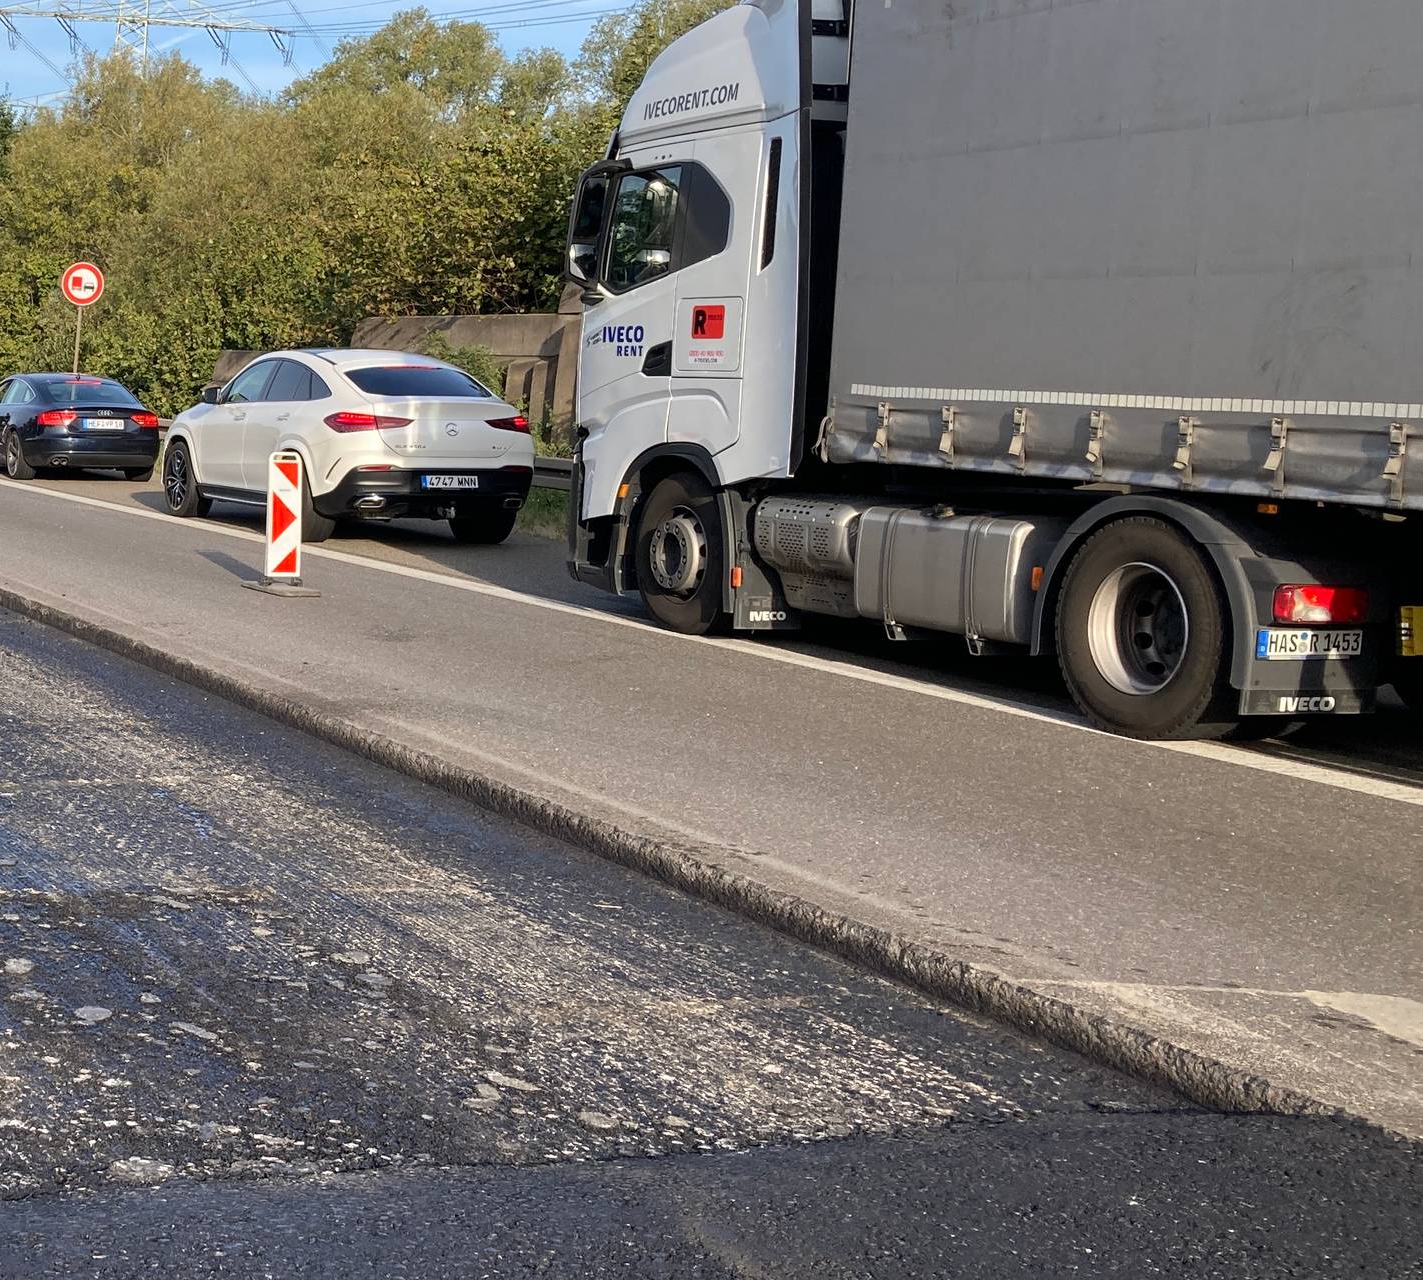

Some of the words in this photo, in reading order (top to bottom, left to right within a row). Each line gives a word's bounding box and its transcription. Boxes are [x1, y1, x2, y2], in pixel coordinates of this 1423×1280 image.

[643, 82, 740, 120] IVECORENT.COM
[602, 325, 644, 343] IVECO
[616, 345, 644, 357] RENT
[429, 477, 454, 487] 4747
[457, 477, 477, 487] MNN
[749, 611, 787, 621] IVECO
[1269, 633, 1299, 652] HAS
[1309, 633, 1319, 652] R
[1323, 633, 1361, 652] 1453
[1279, 696, 1336, 712] IVECO
